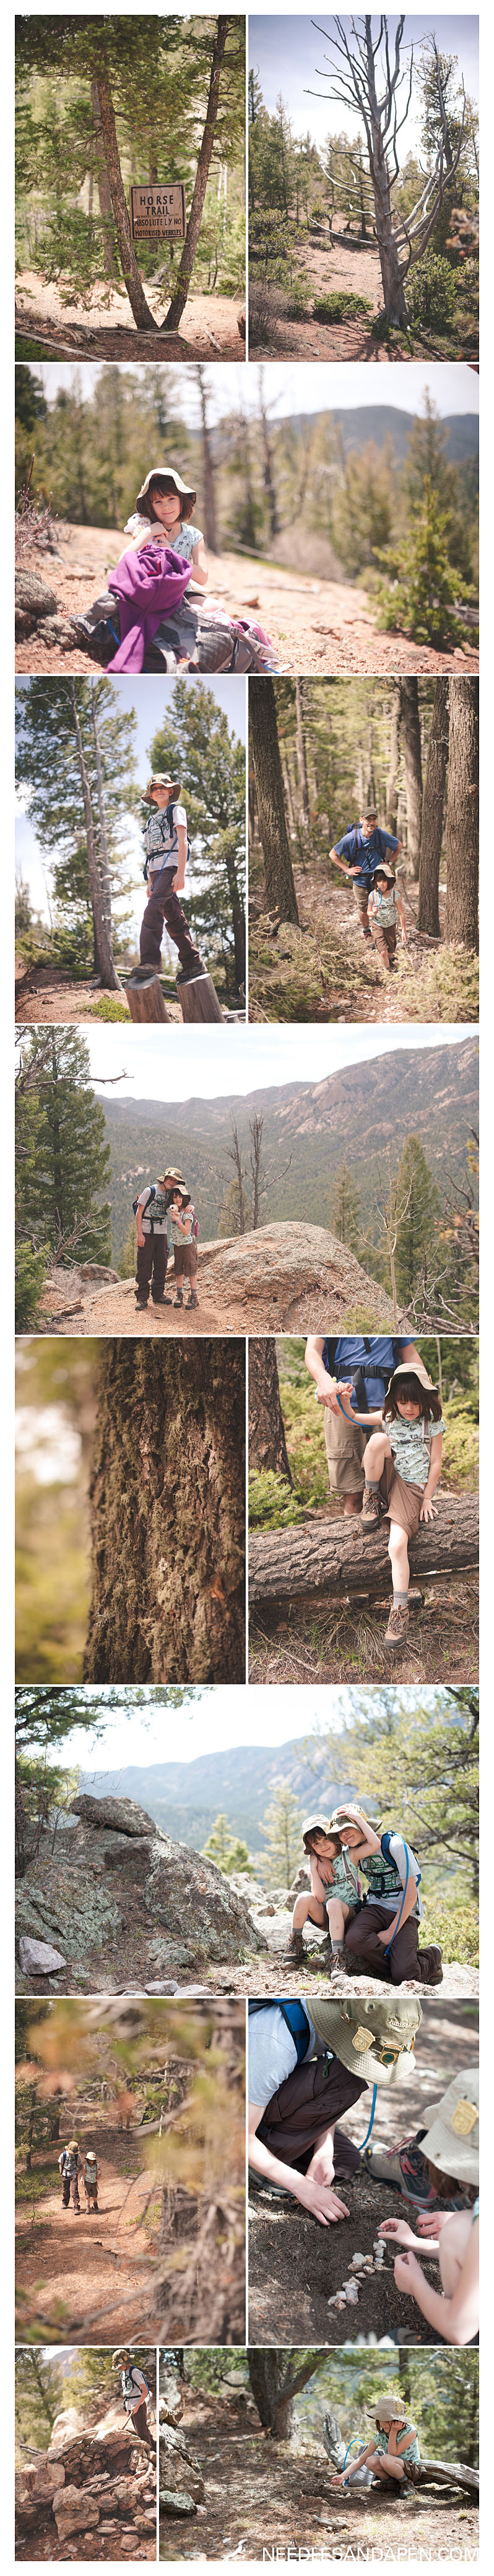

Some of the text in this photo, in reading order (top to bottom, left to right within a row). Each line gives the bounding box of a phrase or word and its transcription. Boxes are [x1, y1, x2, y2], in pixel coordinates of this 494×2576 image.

[140, 195, 174, 206] HORSE
[145, 206, 170, 215] TRAIL
[388, 2018, 407, 2028] Junior
